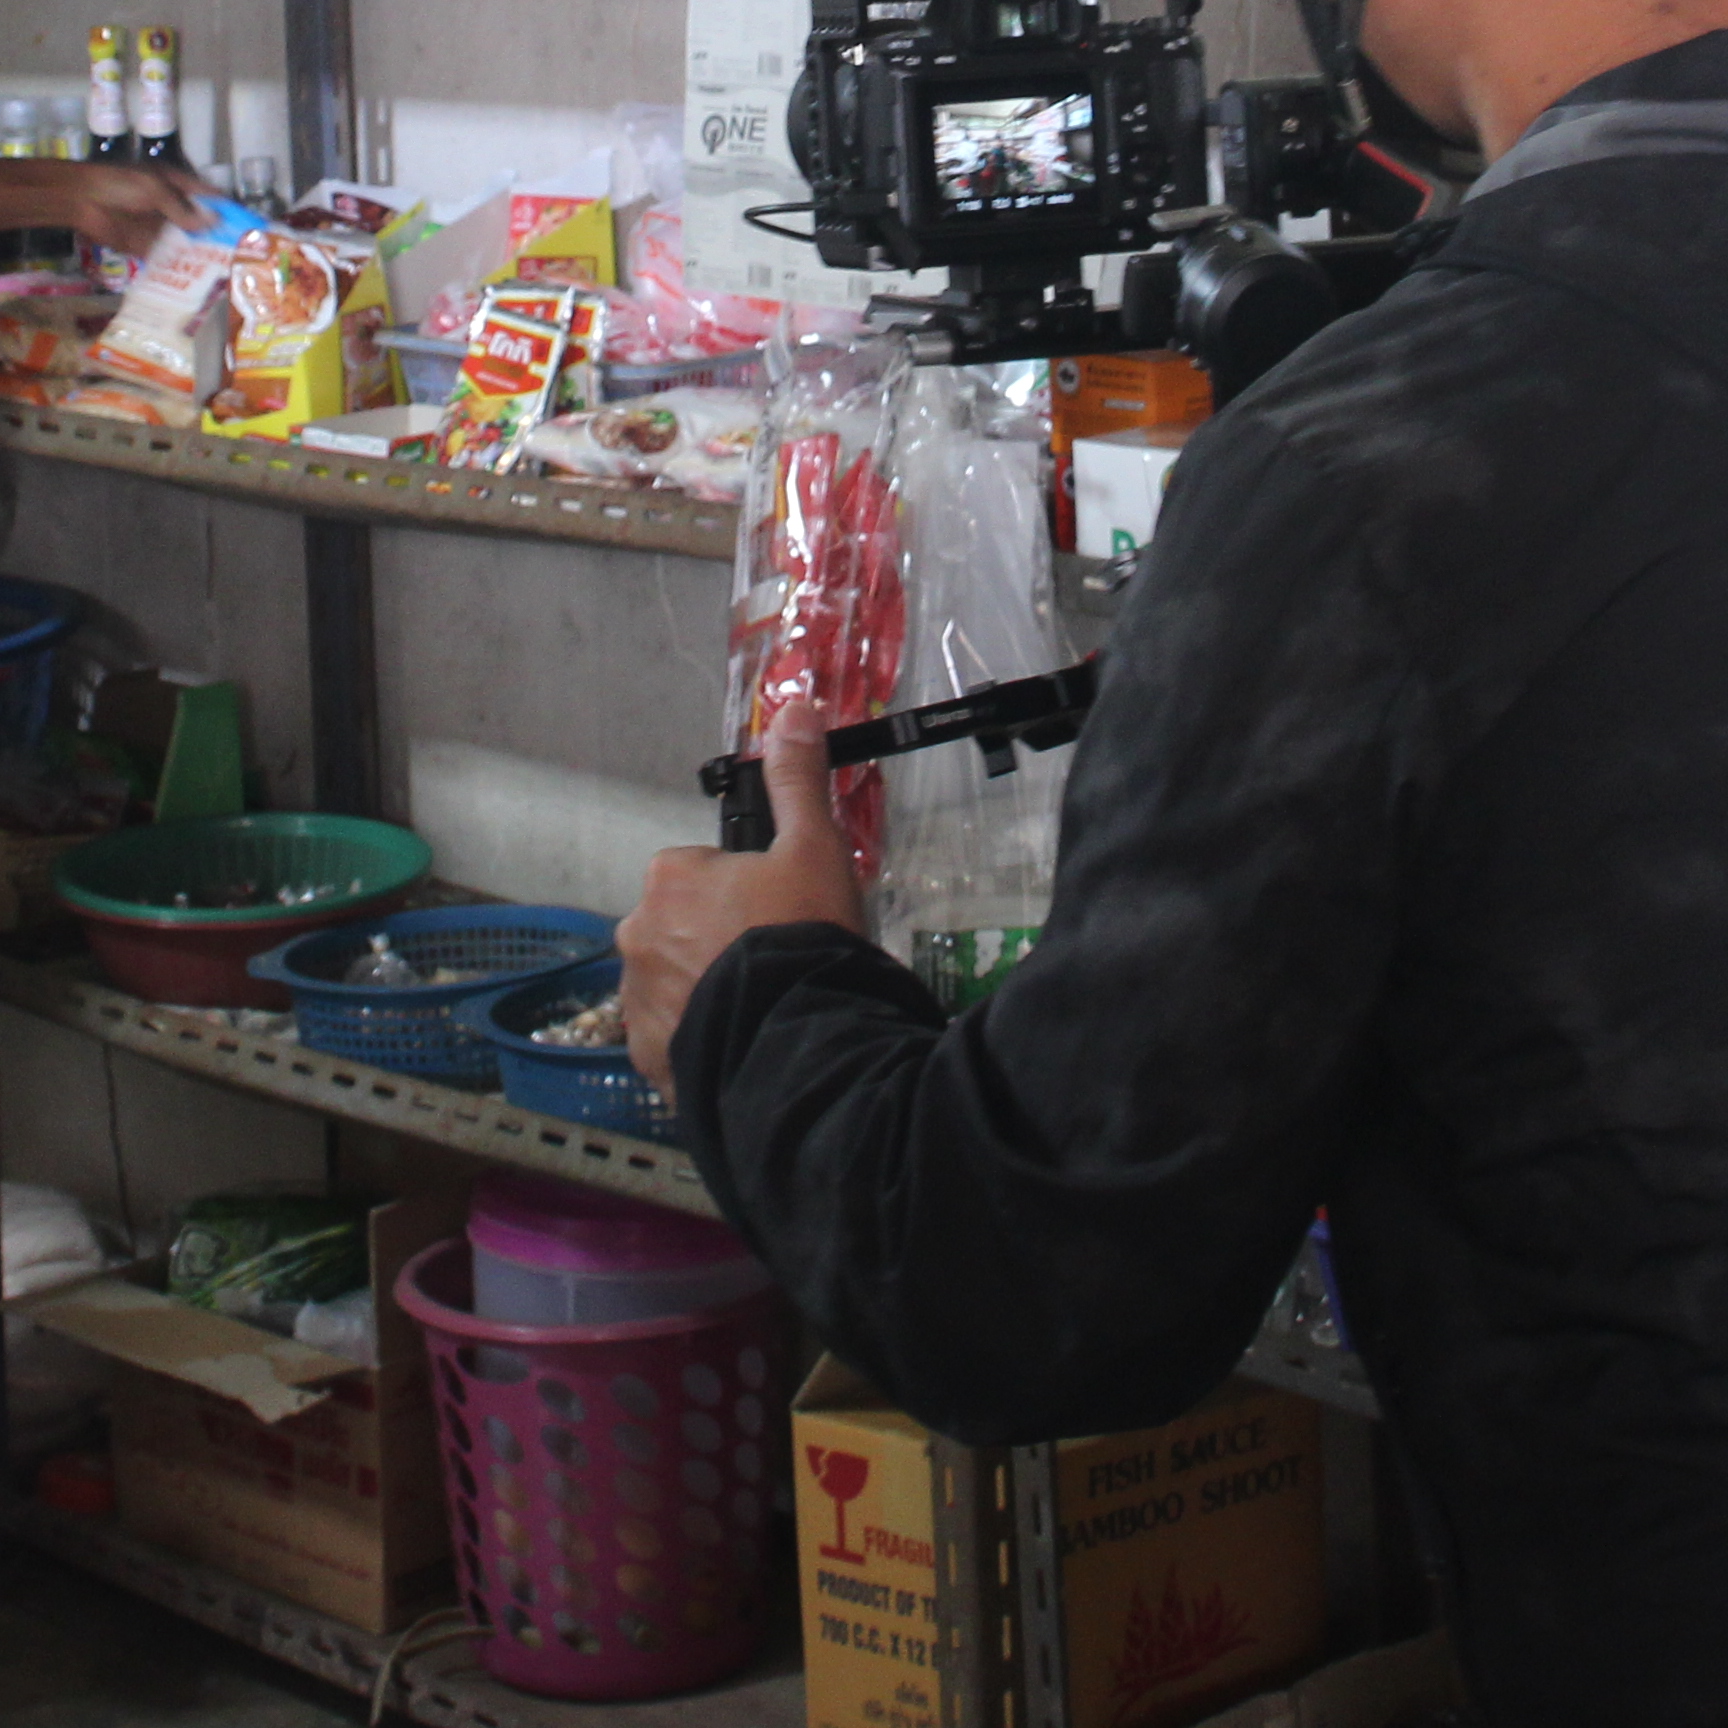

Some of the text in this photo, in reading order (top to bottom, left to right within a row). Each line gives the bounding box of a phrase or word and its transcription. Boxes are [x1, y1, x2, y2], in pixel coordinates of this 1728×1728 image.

[701, 112, 768, 155] ONE
[1087, 1416, 1268, 1499] FISH SAUCE
[1200, 1453, 1304, 1515] SHOOT
[864, 1525, 935, 1570] FRAGIL
[817, 1568, 891, 1613] PRODUCT
[895, 1588, 916, 1616] OF
[820, 1613, 849, 1646] 700
[906, 1637, 926, 1667] 12
